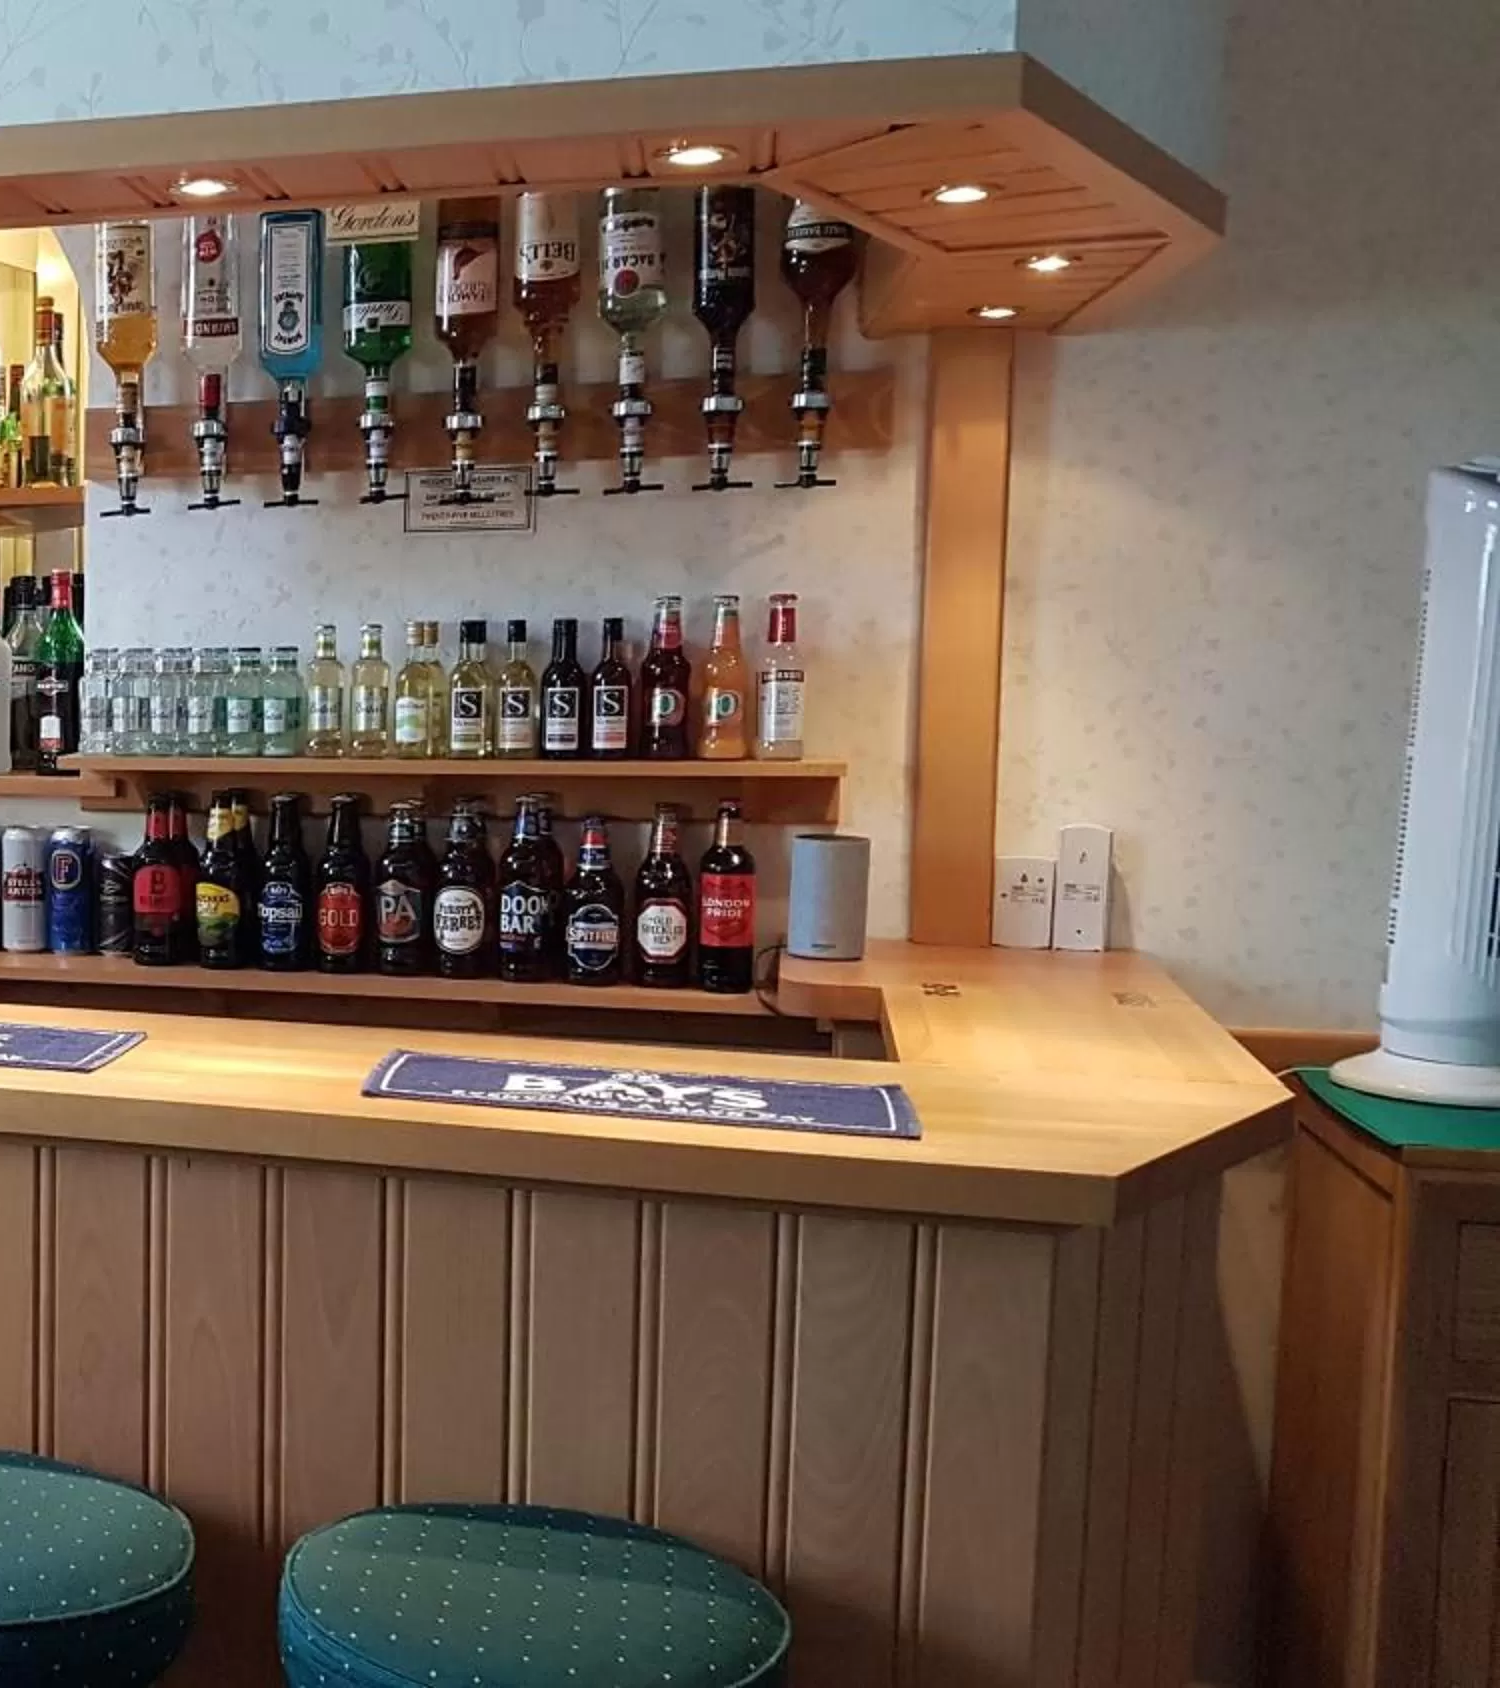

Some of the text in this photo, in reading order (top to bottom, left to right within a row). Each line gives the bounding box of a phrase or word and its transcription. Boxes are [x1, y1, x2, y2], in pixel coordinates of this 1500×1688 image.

[332, 204, 417, 232] Gordon's
[520, 241, 575, 263] BELL'S
[604, 252, 656, 270] BACAR
[460, 693, 477, 716] S
[506, 693, 525, 715] S
[552, 693, 570, 715] S
[602, 692, 620, 714] S
[702, 897, 751, 908] LONDON
[706, 907, 743, 918] PRIDE
[319, 909, 360, 927] GOLD
[500, 914, 536, 934] BAR
[503, 1072, 771, 1109] BAYS
